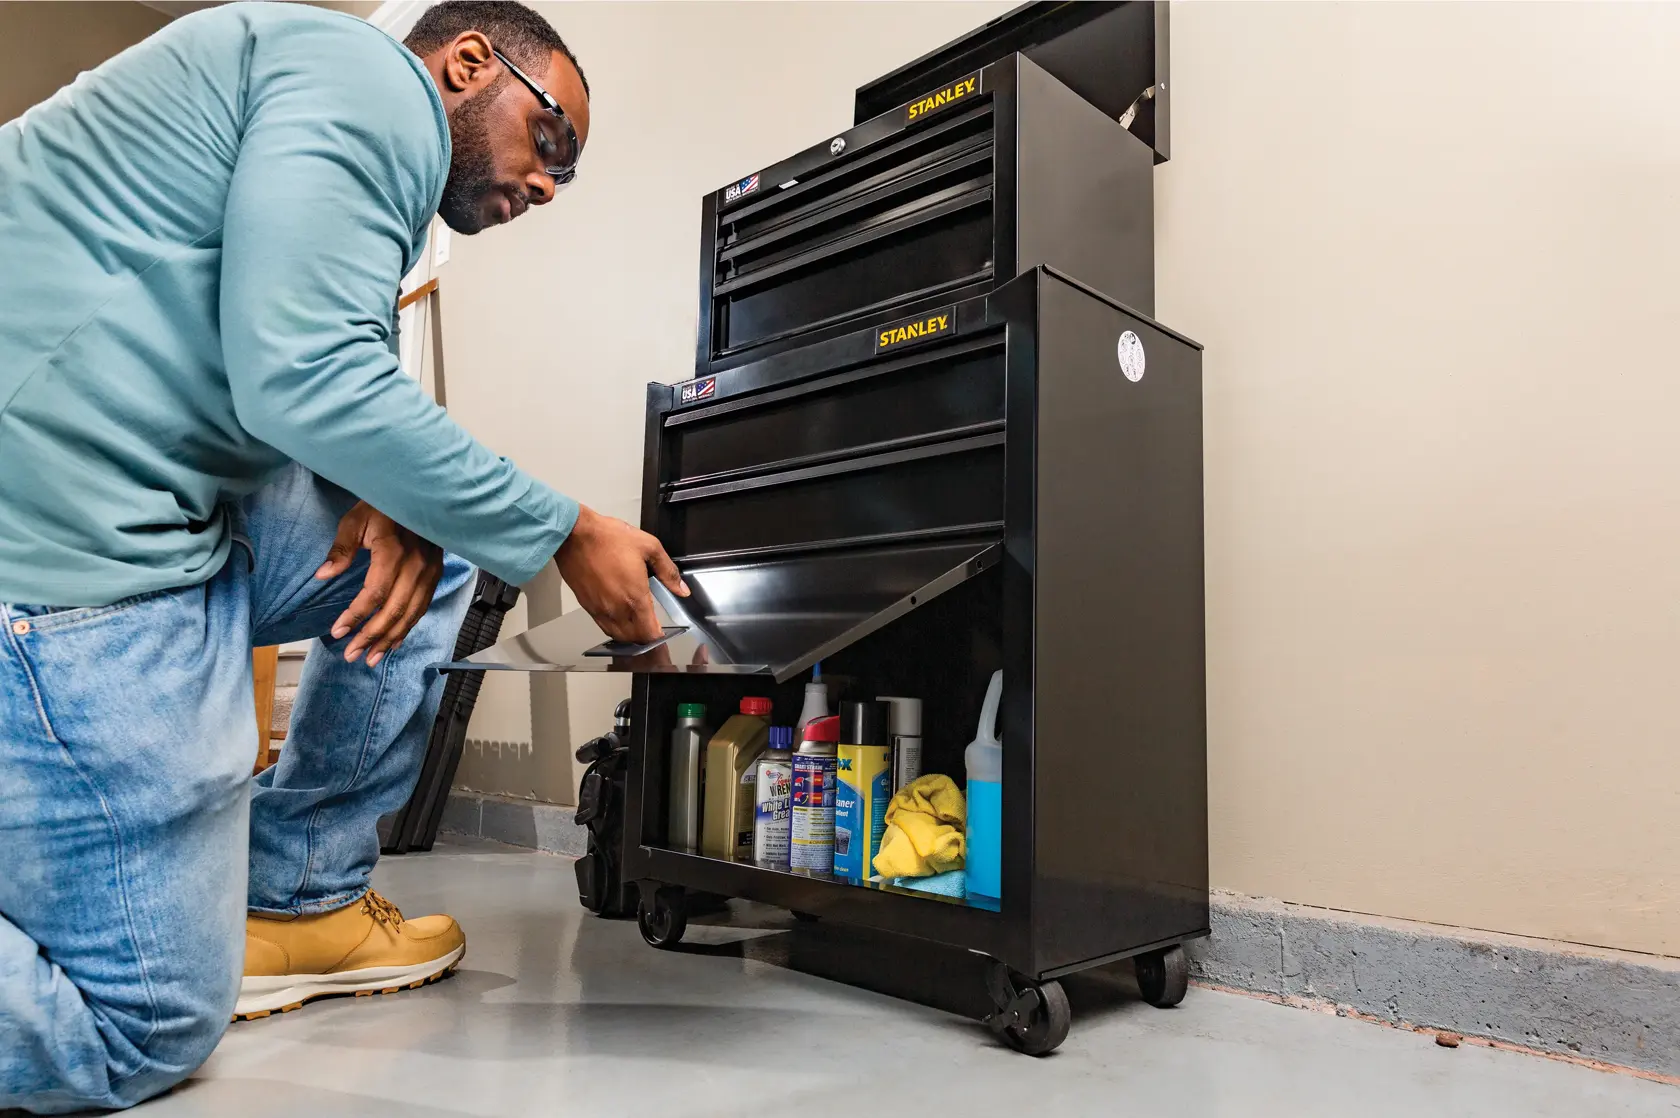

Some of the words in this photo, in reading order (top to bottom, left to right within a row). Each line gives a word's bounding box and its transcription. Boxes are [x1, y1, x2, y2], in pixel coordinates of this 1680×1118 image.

[725, 185, 741, 200] USA
[682, 386, 697, 400] USA
[769, 783, 791, 797] WREN
[762, 800, 783, 813] White
[772, 810, 790, 821] Grea
